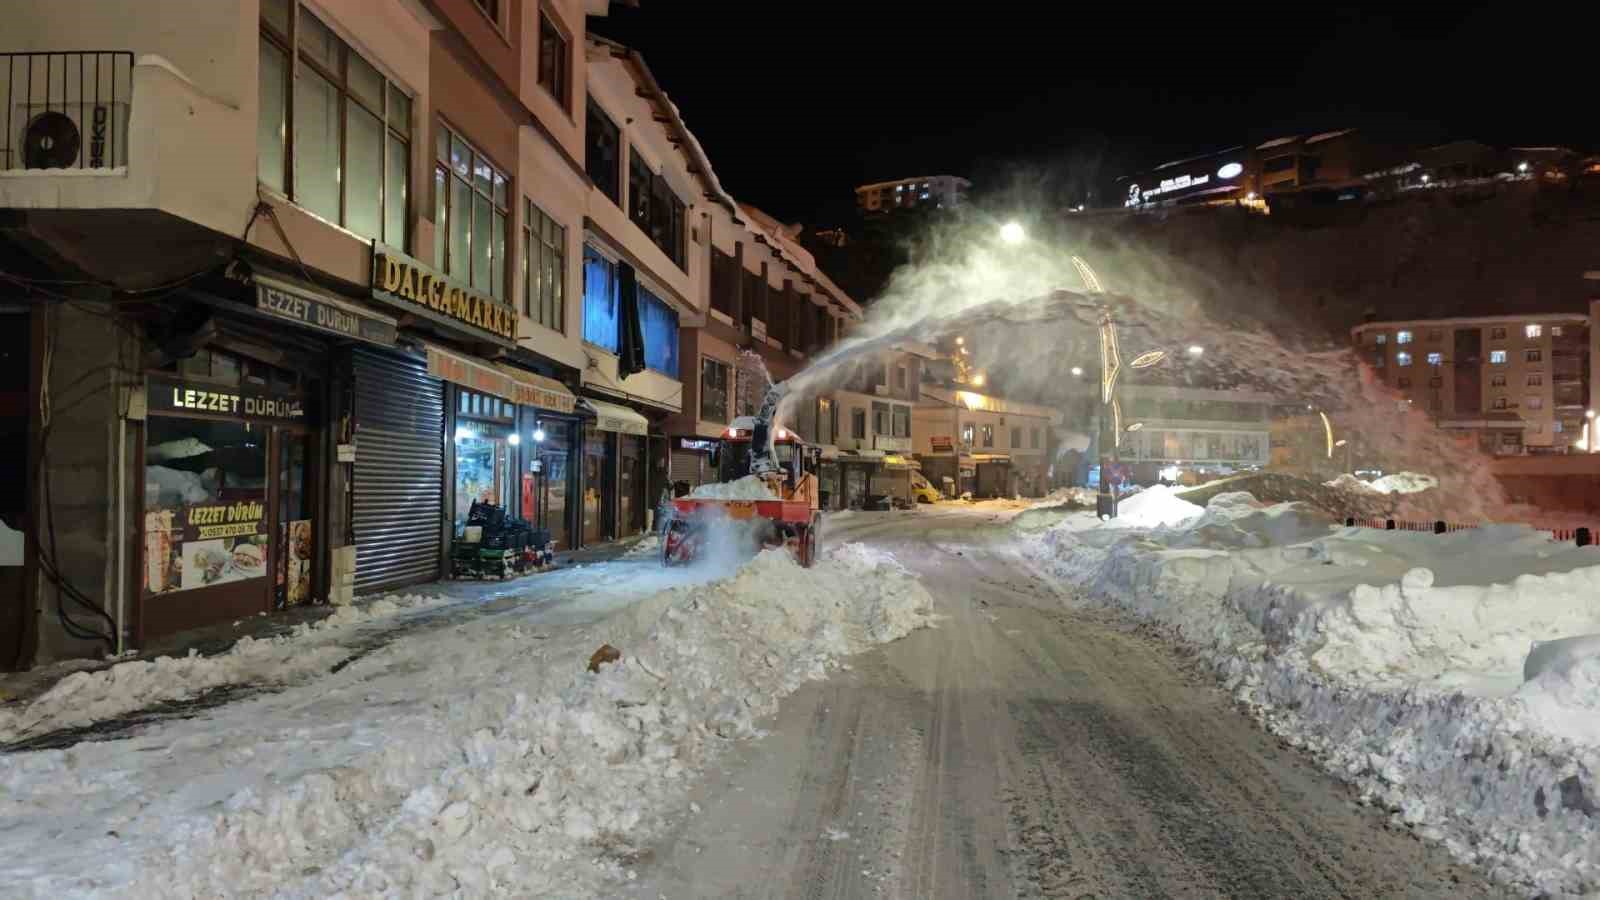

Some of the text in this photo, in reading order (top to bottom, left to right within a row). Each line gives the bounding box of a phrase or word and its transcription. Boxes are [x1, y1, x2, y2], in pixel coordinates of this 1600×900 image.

[257, 286, 310, 321] LEZZET
[384, 255, 519, 342] DALGA MARKET
[173, 387, 240, 413] LEZZET
[188, 501, 263, 525] LEZZET DÜRÜM
